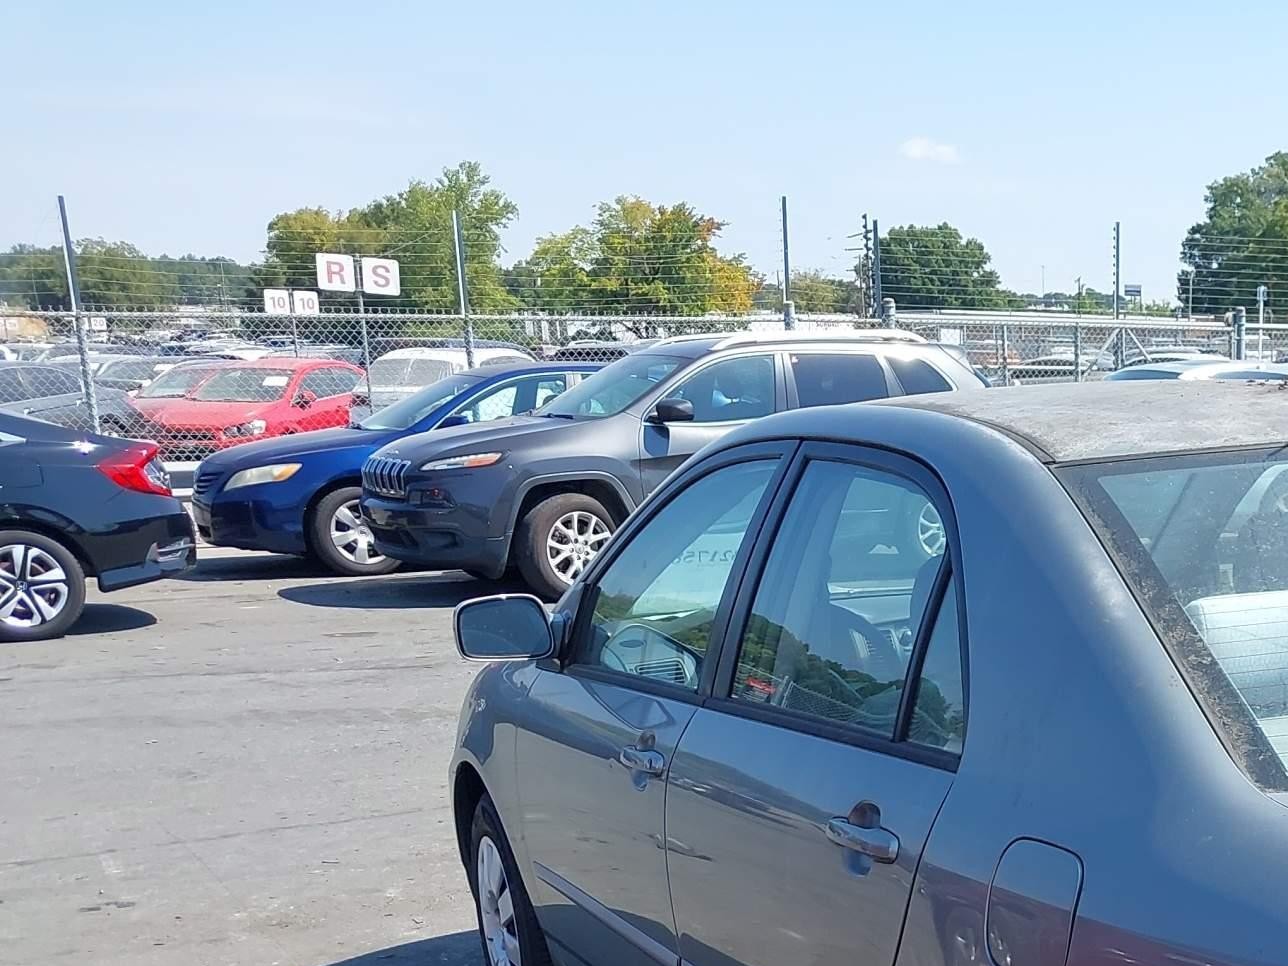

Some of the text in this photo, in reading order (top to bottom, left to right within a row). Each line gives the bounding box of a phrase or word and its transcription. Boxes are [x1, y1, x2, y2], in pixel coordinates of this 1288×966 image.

[326, 260, 346, 285] R
[371, 264, 391, 288] S
[270, 296, 286, 309] 10
[299, 297, 315, 310] 10
